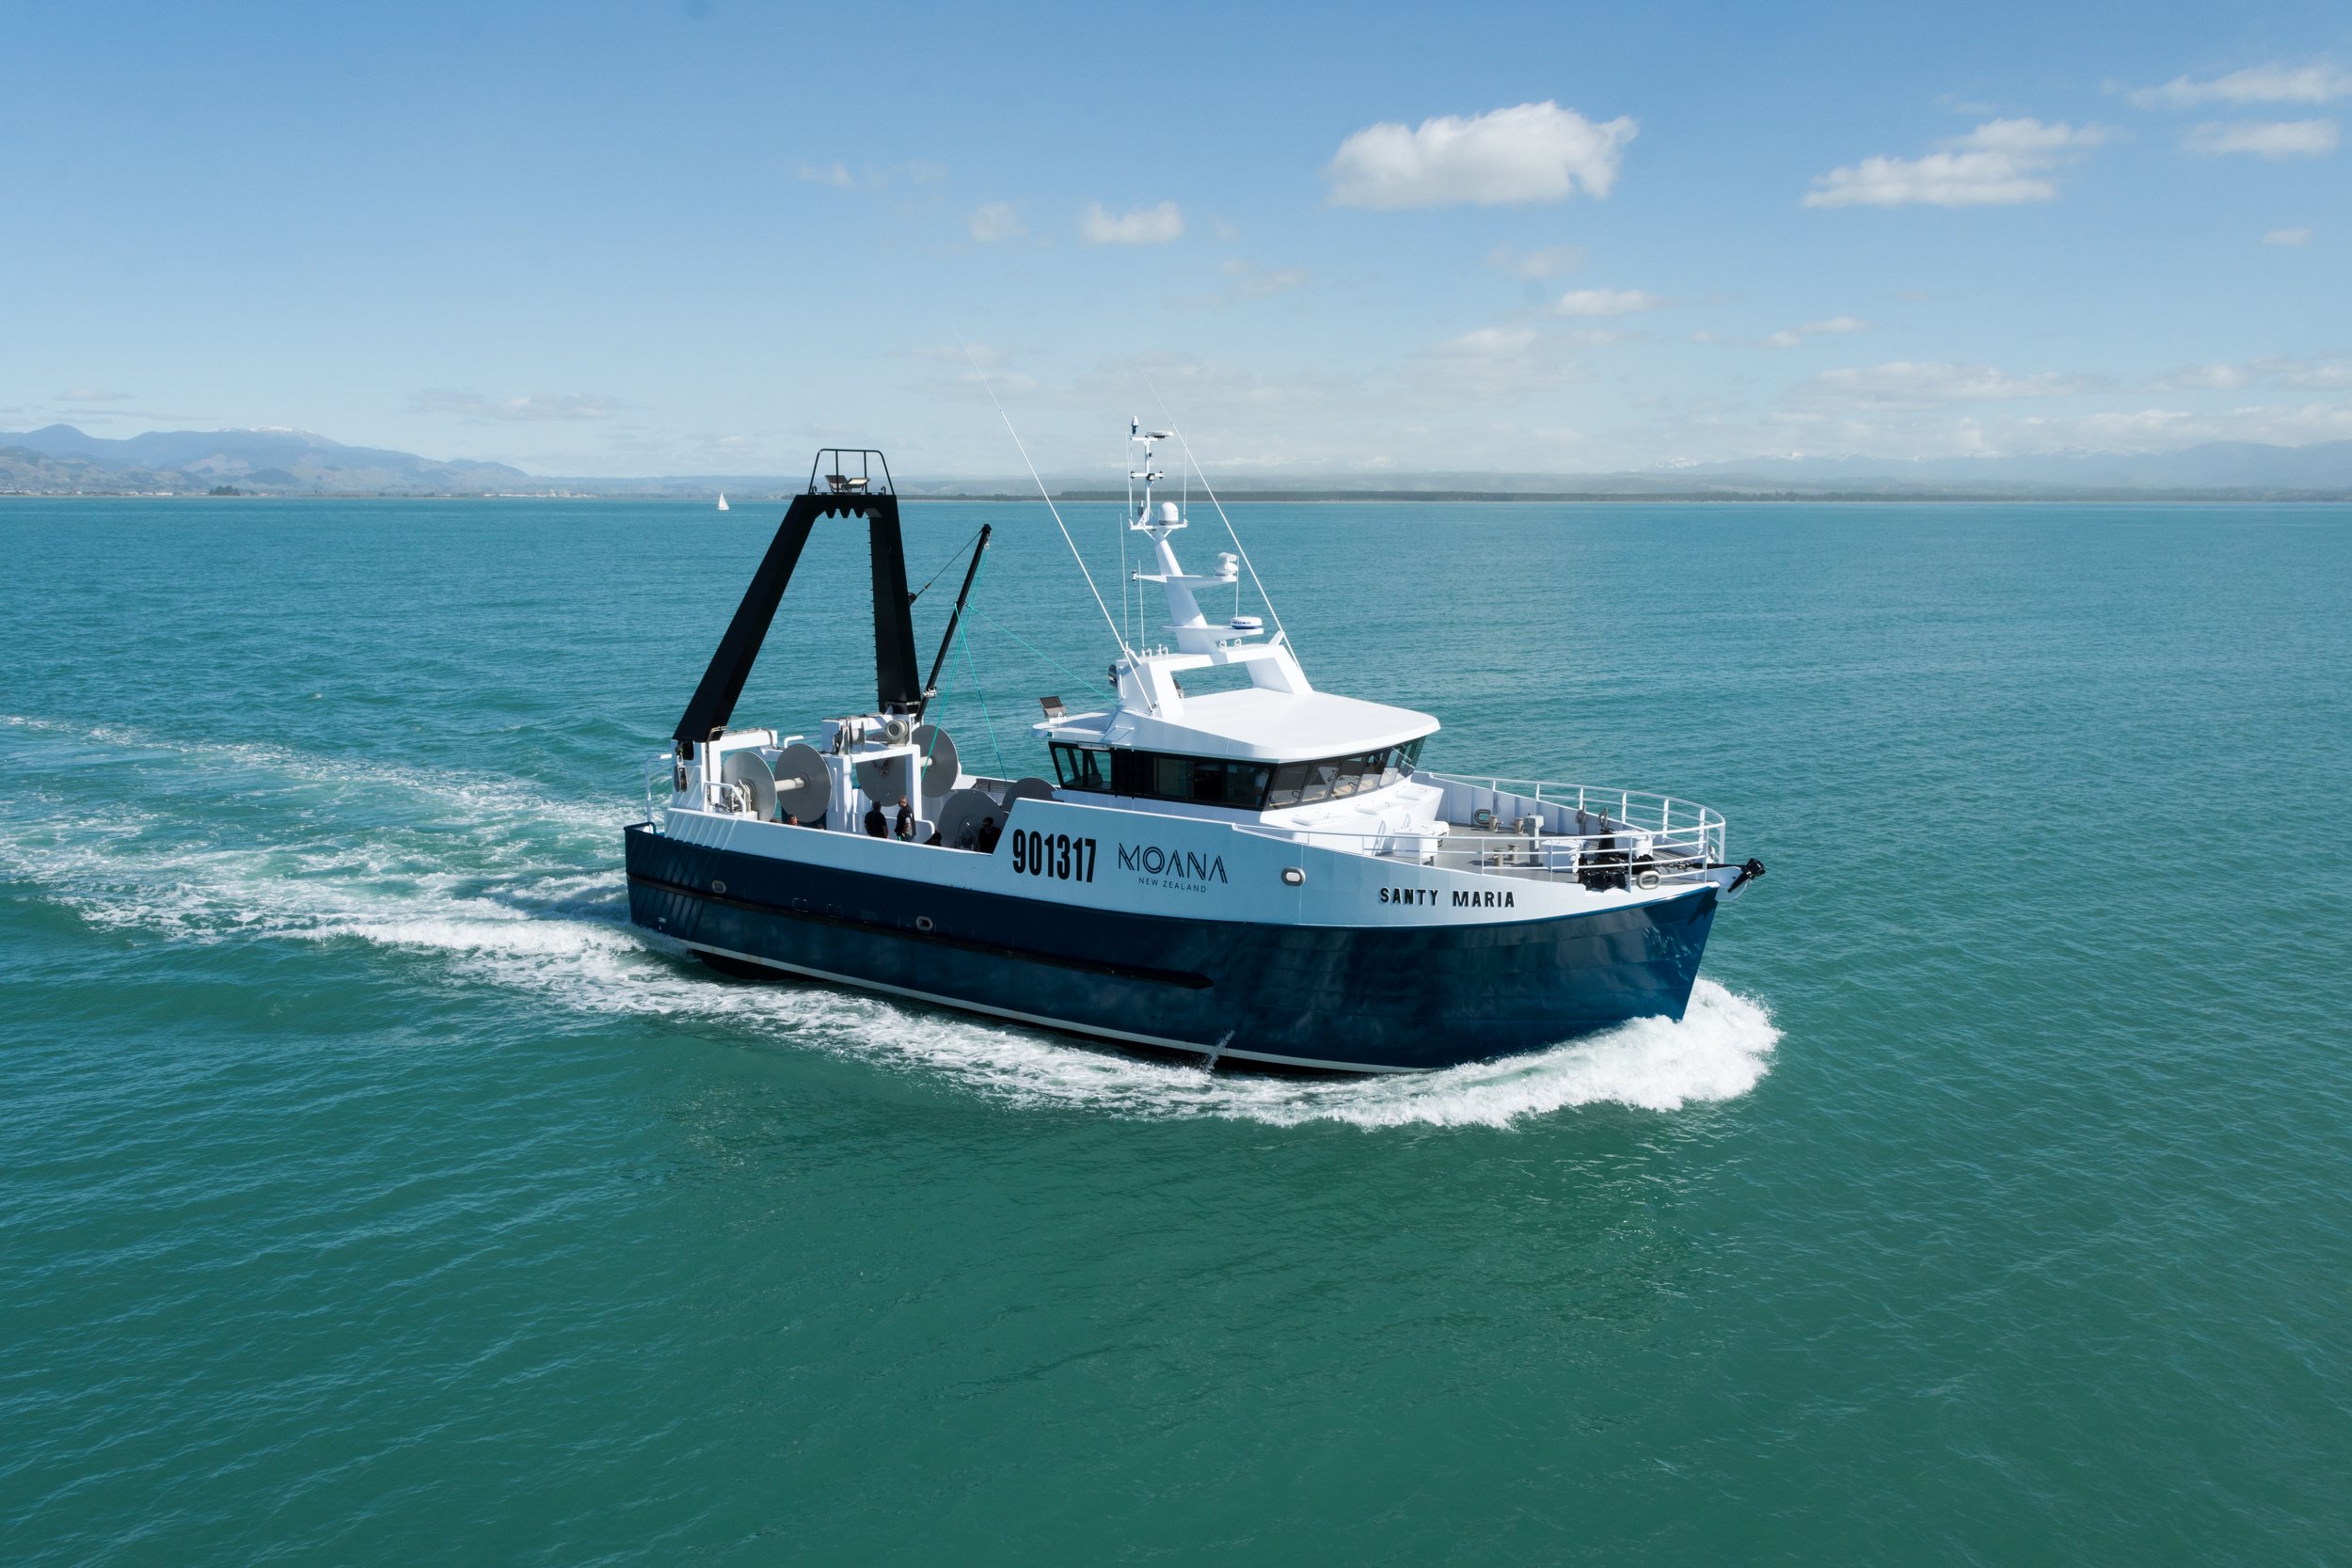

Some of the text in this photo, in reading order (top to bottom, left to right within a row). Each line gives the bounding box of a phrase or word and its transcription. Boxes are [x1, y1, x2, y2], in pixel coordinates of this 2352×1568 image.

[1012, 829, 1096, 882] 901317
[1119, 843, 1228, 883] MOANA
[1138, 877, 1207, 894] NEW ZEALAND
[1380, 888, 1515, 908] SANTY MARIA
